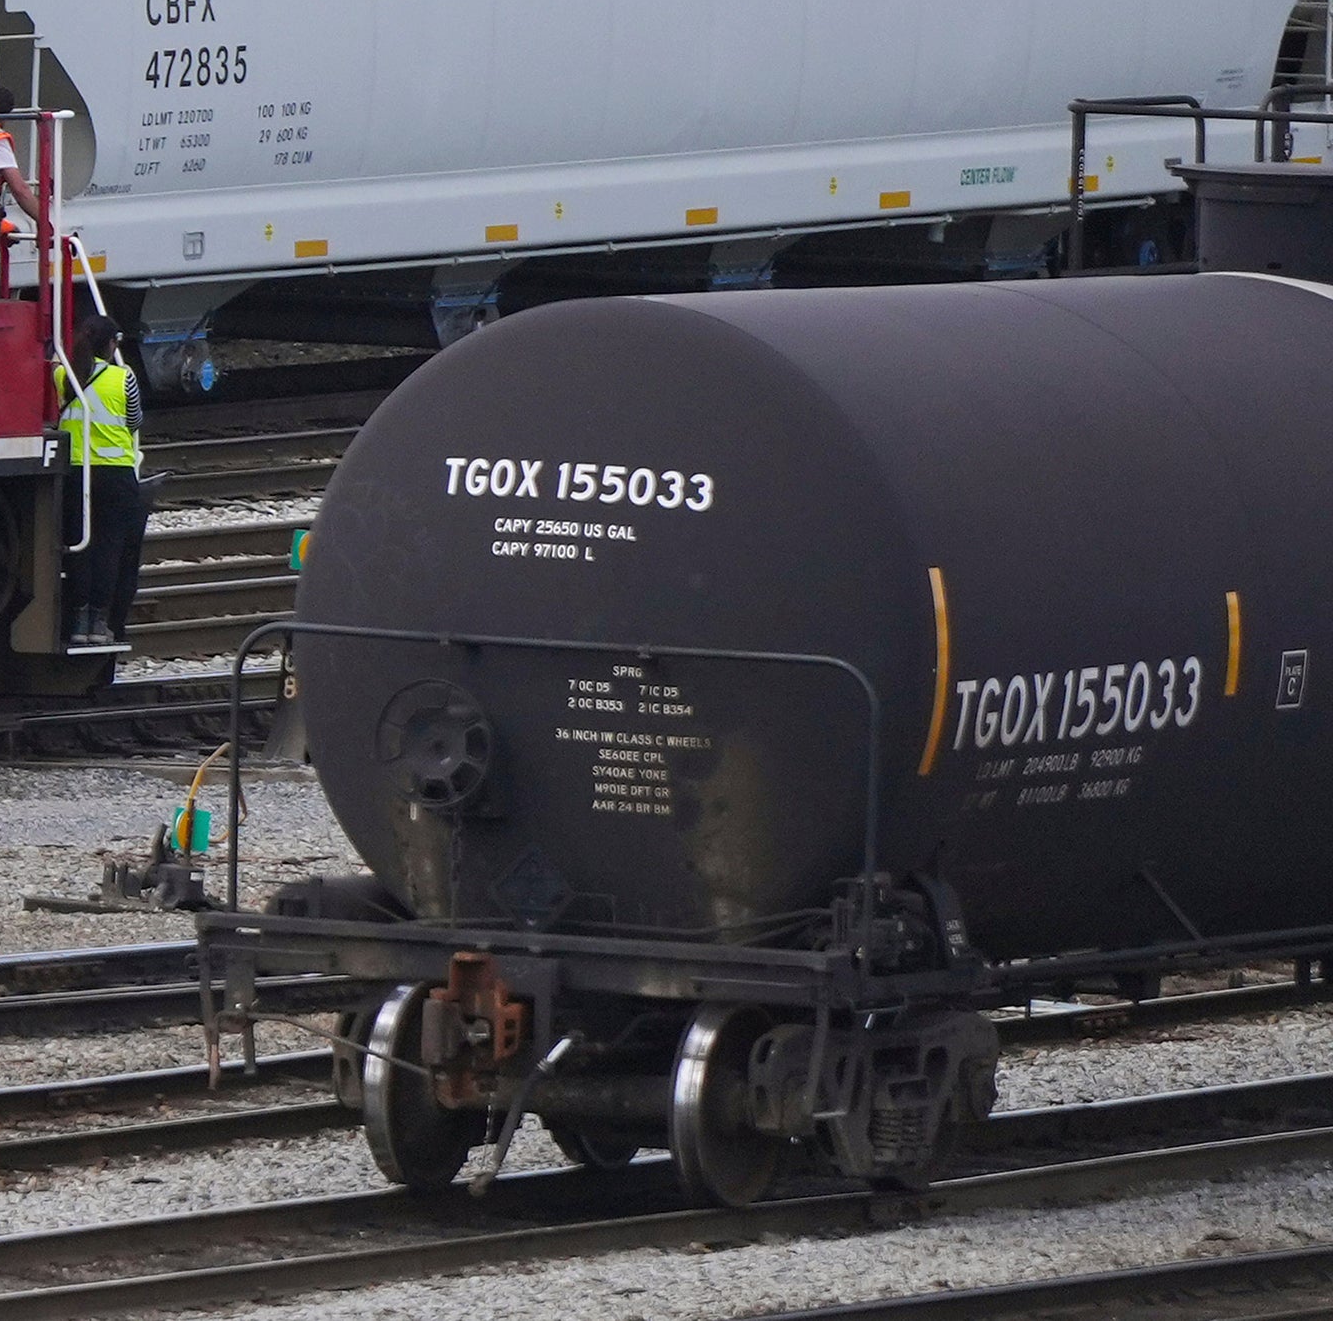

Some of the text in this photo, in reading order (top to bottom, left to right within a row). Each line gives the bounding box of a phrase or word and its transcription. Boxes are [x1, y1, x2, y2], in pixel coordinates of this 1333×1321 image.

[145, 45, 248, 89] 472835
[299, 101, 312, 116] KG
[43, 440, 59, 468] F
[445, 457, 715, 512] TGOX 155033
[494, 517, 637, 542] CAPY 25650 US GAL
[491, 540, 596, 562] CAPY 97100 L
[612, 665, 643, 678] SPRG
[1285, 664, 1303, 677] PLATE
[596, 681, 611, 694] D5
[663, 686, 679, 698] D5
[1286, 678, 1297, 696] C
[567, 697, 576, 709] 2
[638, 702, 646, 713] 2
[952, 655, 1202, 751] TGOX 155033
[555, 728, 569, 740] 36
[572, 729, 598, 742] INCH
[616, 732, 652, 746] CLASS
[643, 751, 665, 764] CPL
[638, 768, 668, 781] YOKE
[630, 785, 651, 797] DFT
[654, 786, 670, 798] GR
[591, 799, 616, 811] AAR
[618, 801, 633, 813] 24
